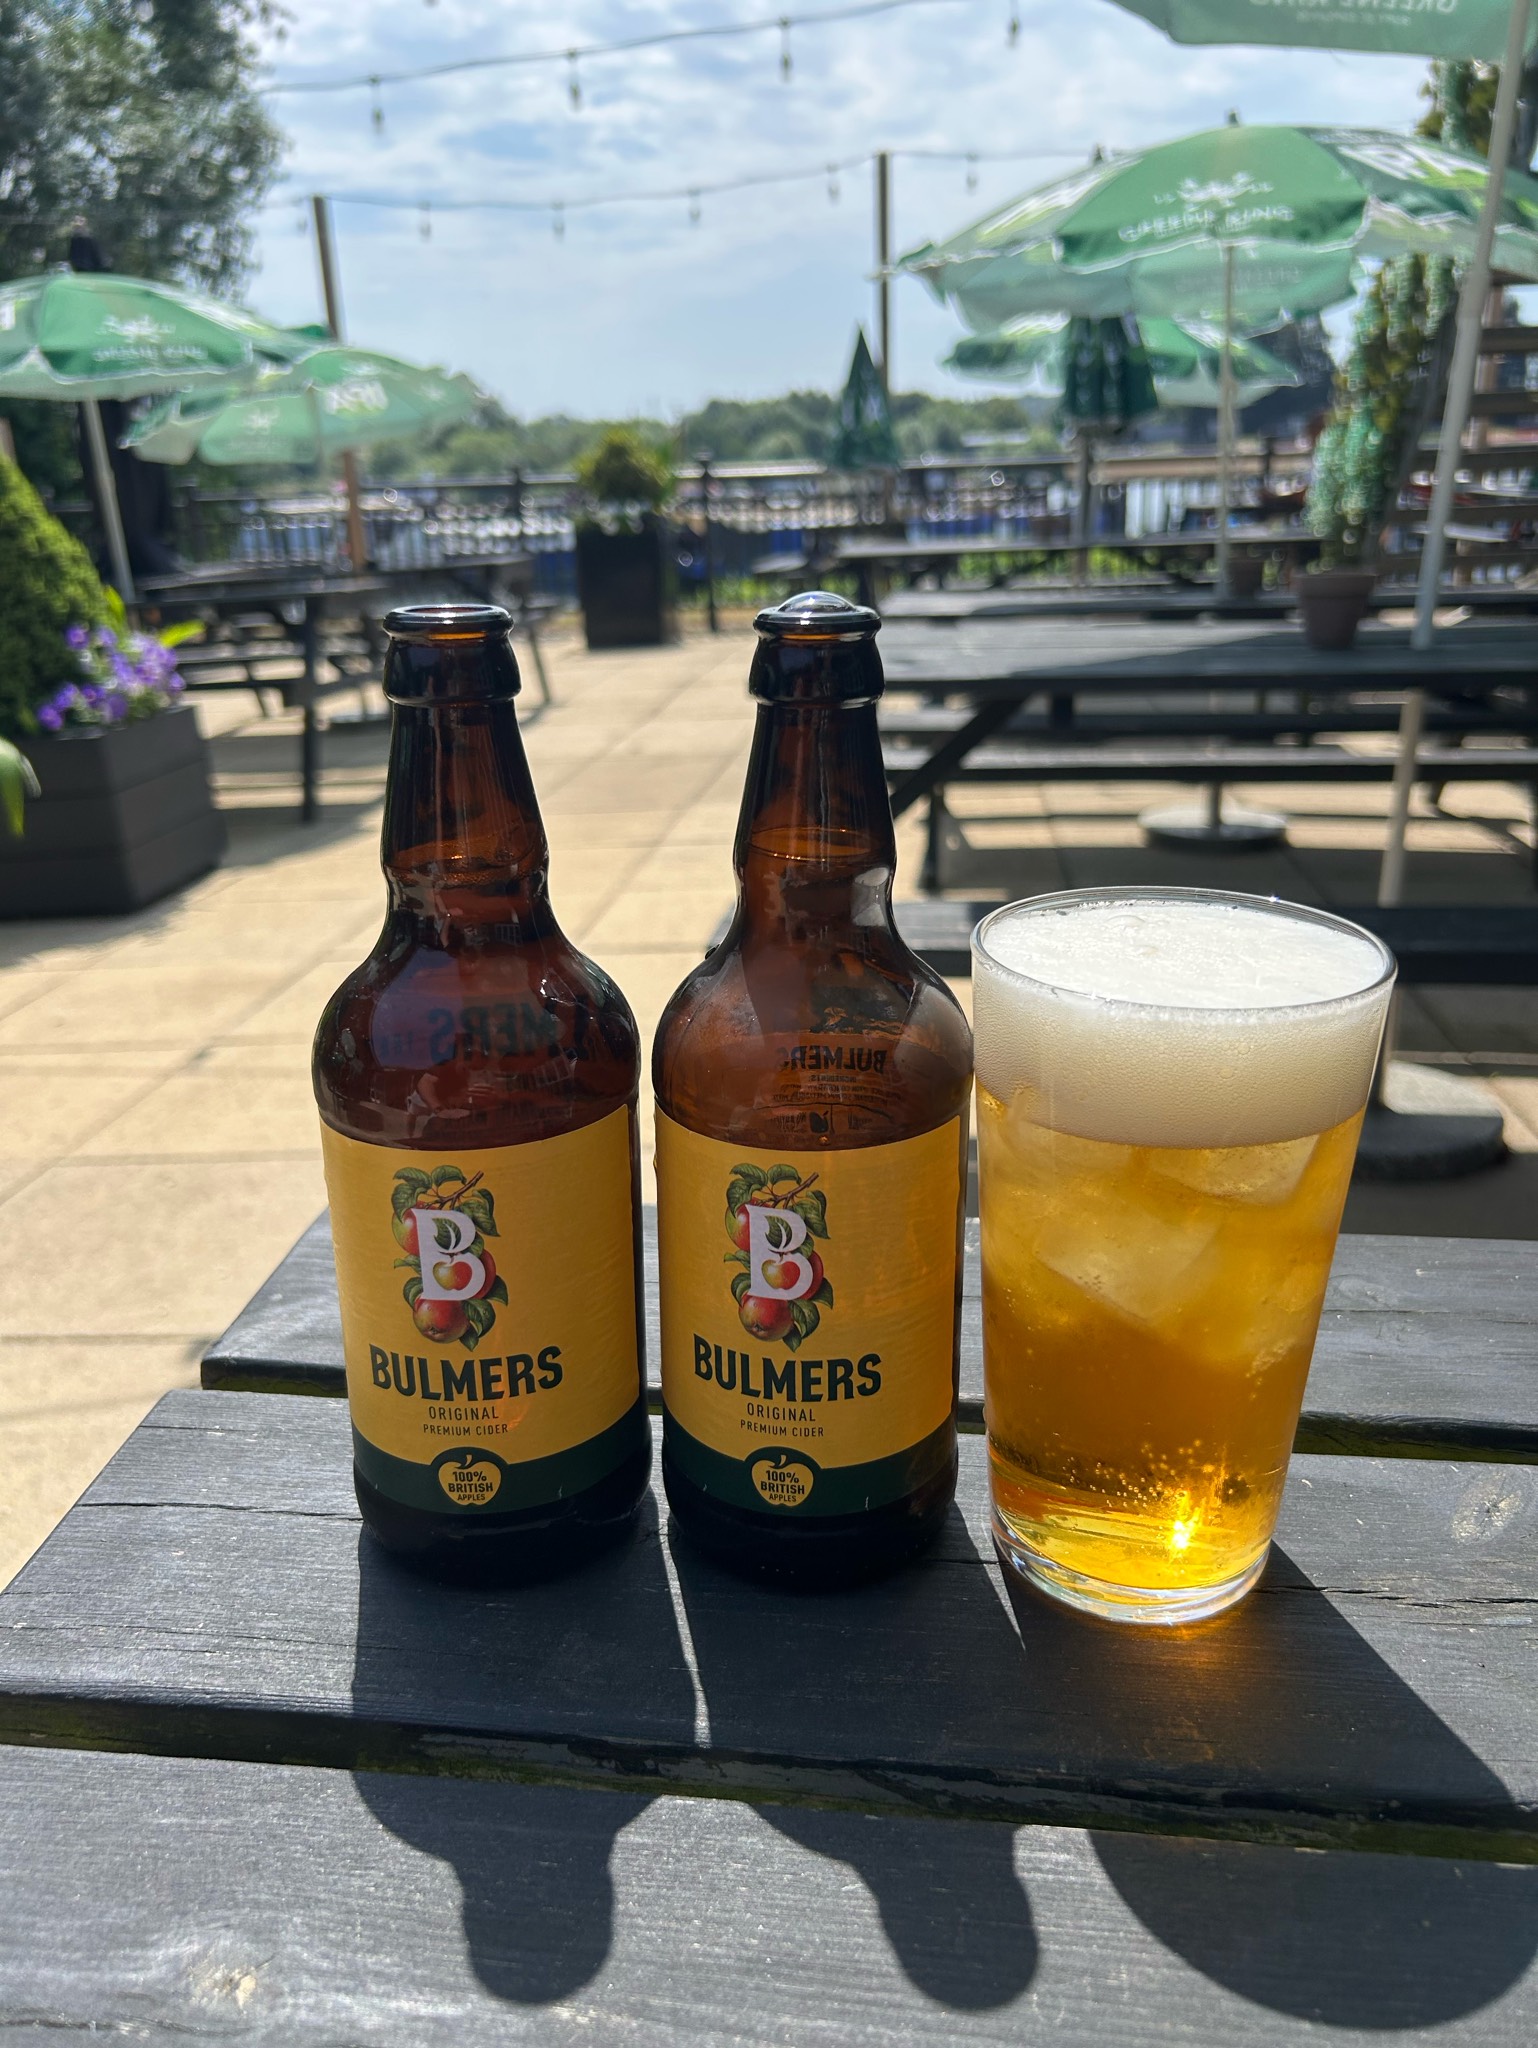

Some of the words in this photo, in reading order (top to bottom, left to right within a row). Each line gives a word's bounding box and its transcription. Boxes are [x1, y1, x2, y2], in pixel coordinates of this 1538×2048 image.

[411, 1208, 486, 1301] B
[745, 1204, 813, 1301] B
[369, 1344, 563, 1401] BULMERS
[694, 1333, 882, 1403] BULMERS
[428, 1406, 499, 1421] ORIGINAL
[747, 1402, 816, 1422] ORIGINAL
[423, 1423, 471, 1436] PREMIUM
[476, 1423, 509, 1436] CIDER
[740, 1419, 787, 1437] PREMIUM
[792, 1427, 824, 1437] CIDER
[452, 1471, 487, 1482] 100%
[765, 1469, 800, 1484] 100%
[448, 1482, 494, 1493] BRITISH
[760, 1480, 805, 1495] BRITISH
[457, 1493, 486, 1501] APPLES
[769, 1493, 797, 1503] APPLES
